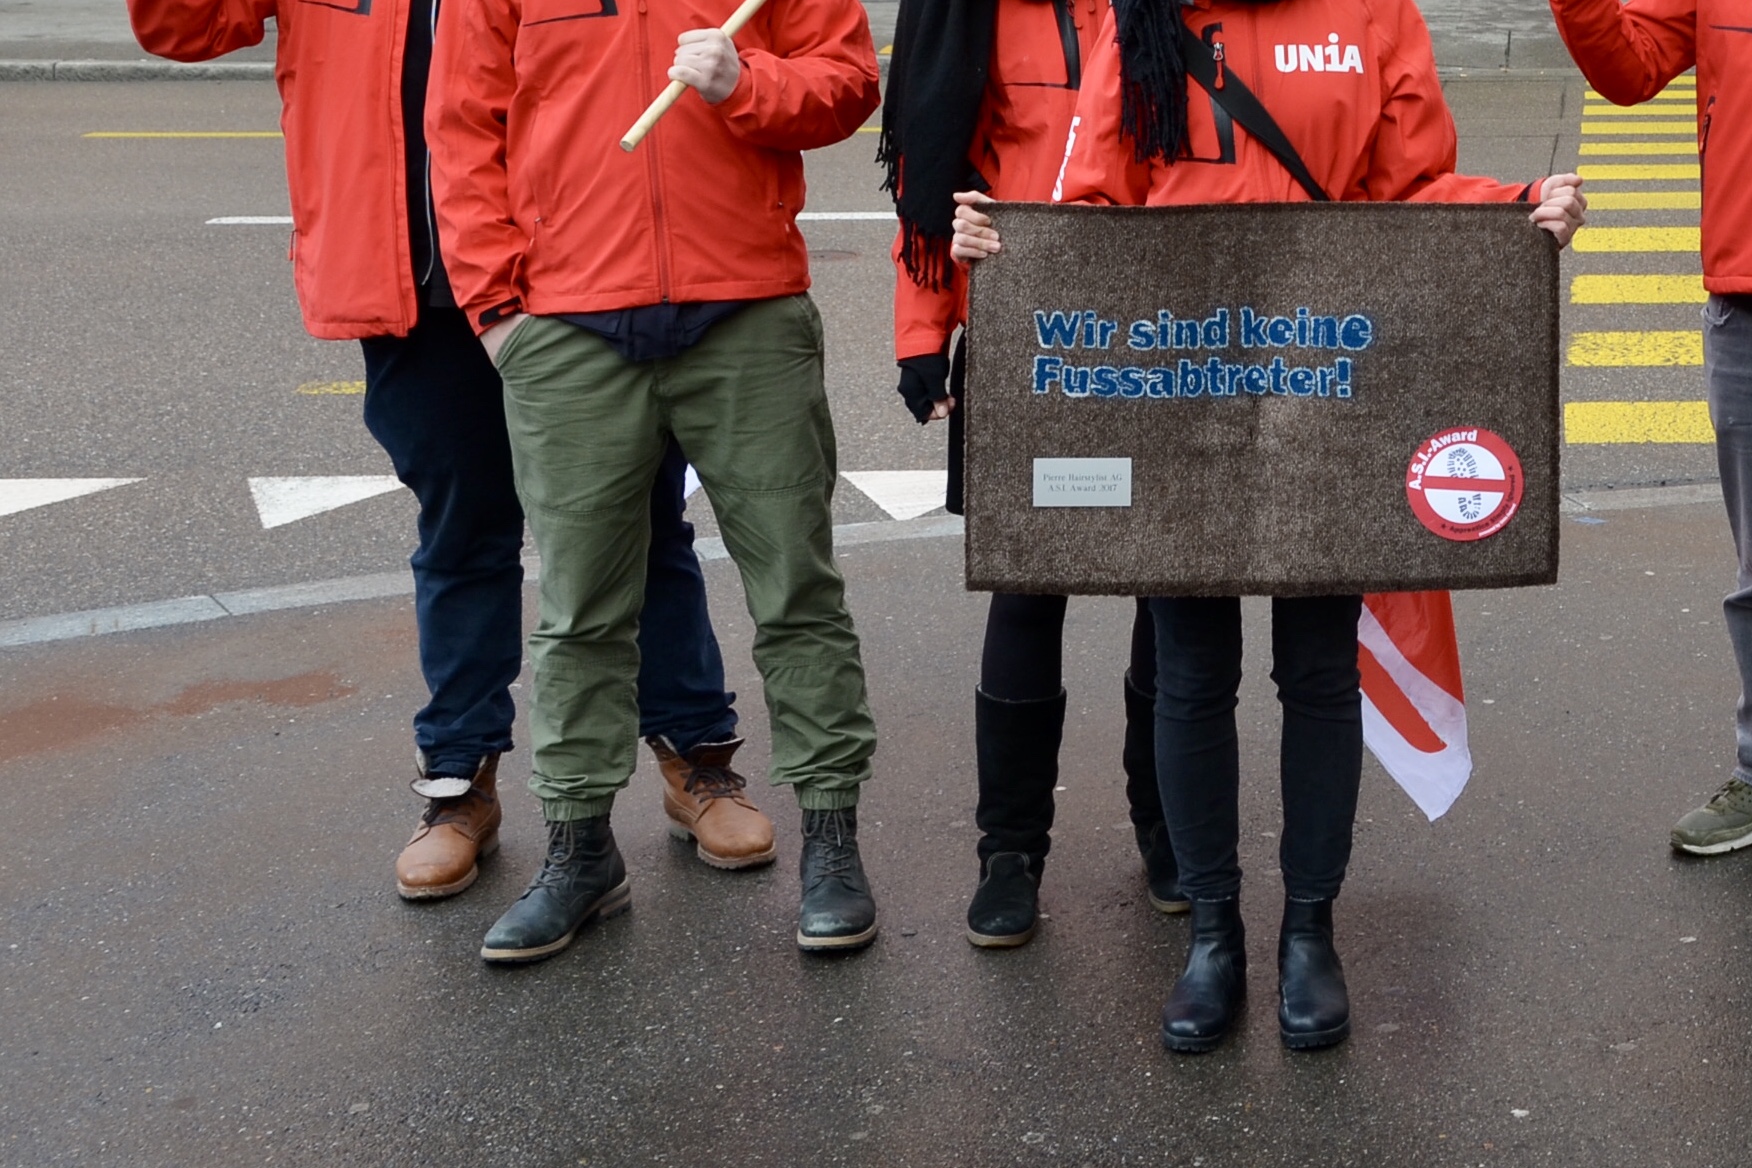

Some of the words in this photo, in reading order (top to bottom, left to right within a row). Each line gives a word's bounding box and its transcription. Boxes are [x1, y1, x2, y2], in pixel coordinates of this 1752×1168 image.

[1033, 309, 1118, 349] Wir
[1127, 307, 1230, 351] sind
[1239, 306, 1373, 350] keine
[1032, 355, 1352, 399] Fussabtreter!
[1043, 473, 1066, 481] Pierre
[1068, 473, 1107, 483] Hairstylist
[1110, 473, 1123, 481] AG
[1070, 484, 1096, 492] Award
